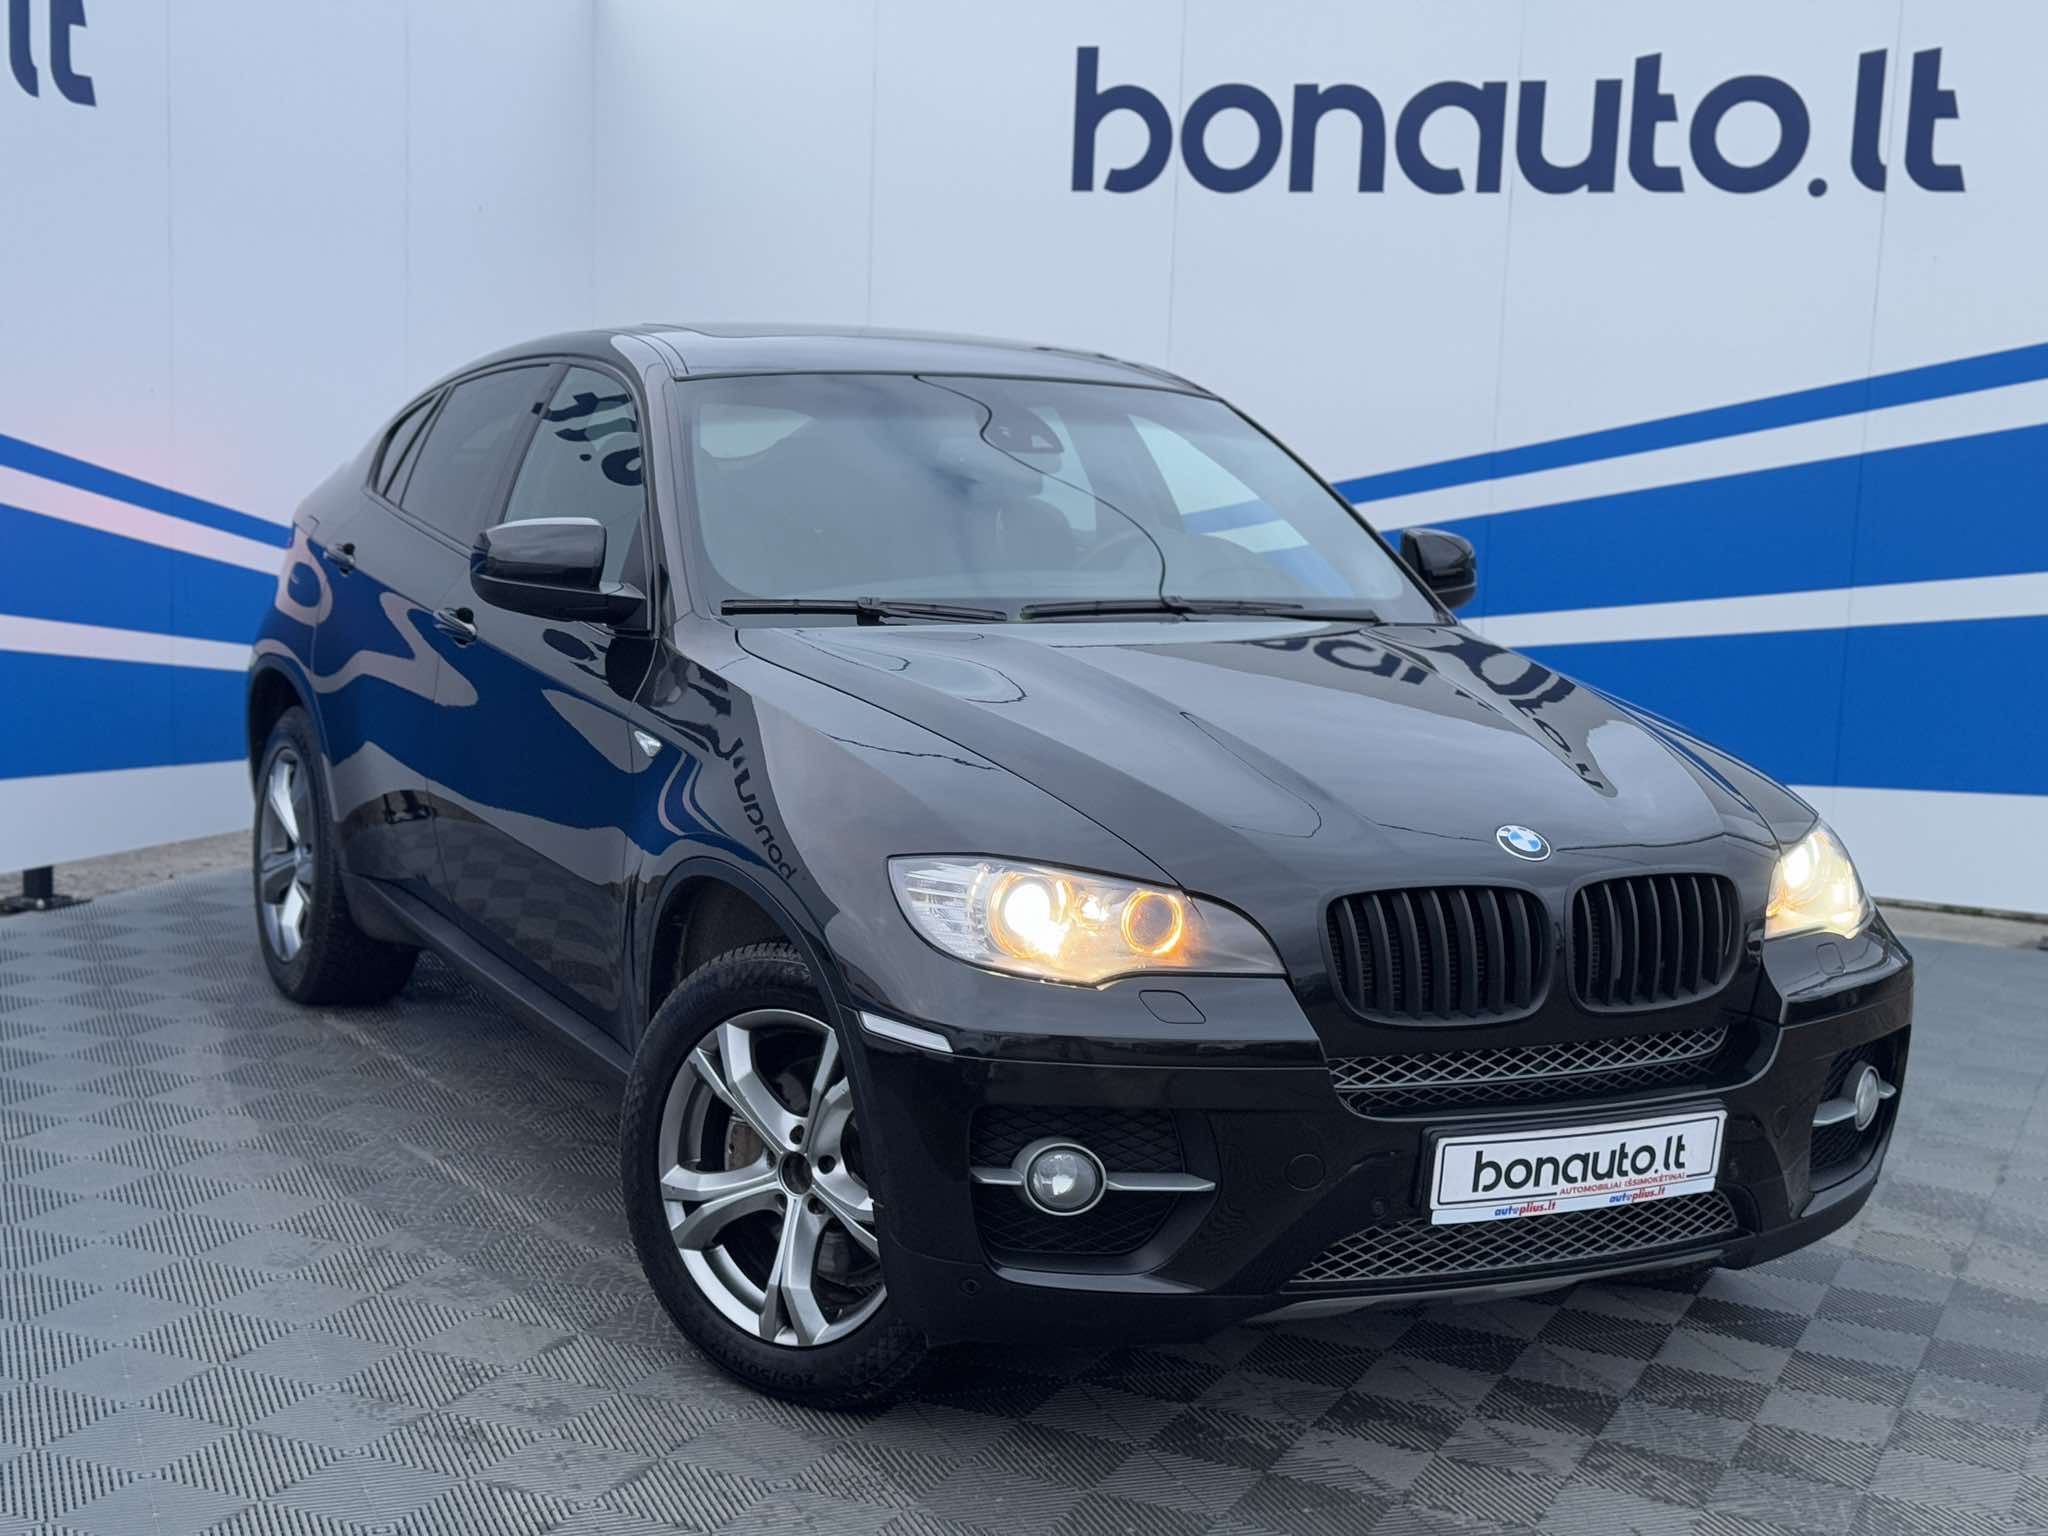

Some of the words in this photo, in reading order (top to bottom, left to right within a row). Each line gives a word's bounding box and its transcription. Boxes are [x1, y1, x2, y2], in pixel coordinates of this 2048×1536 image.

[1071, 46, 1966, 198] bonauto.lt
[1471, 1134, 1686, 1193] bonauto.lt
[1559, 1181, 1622, 1196] AUTOMOBILIAI
[1494, 1201, 1557, 1217] autoplius.lt
